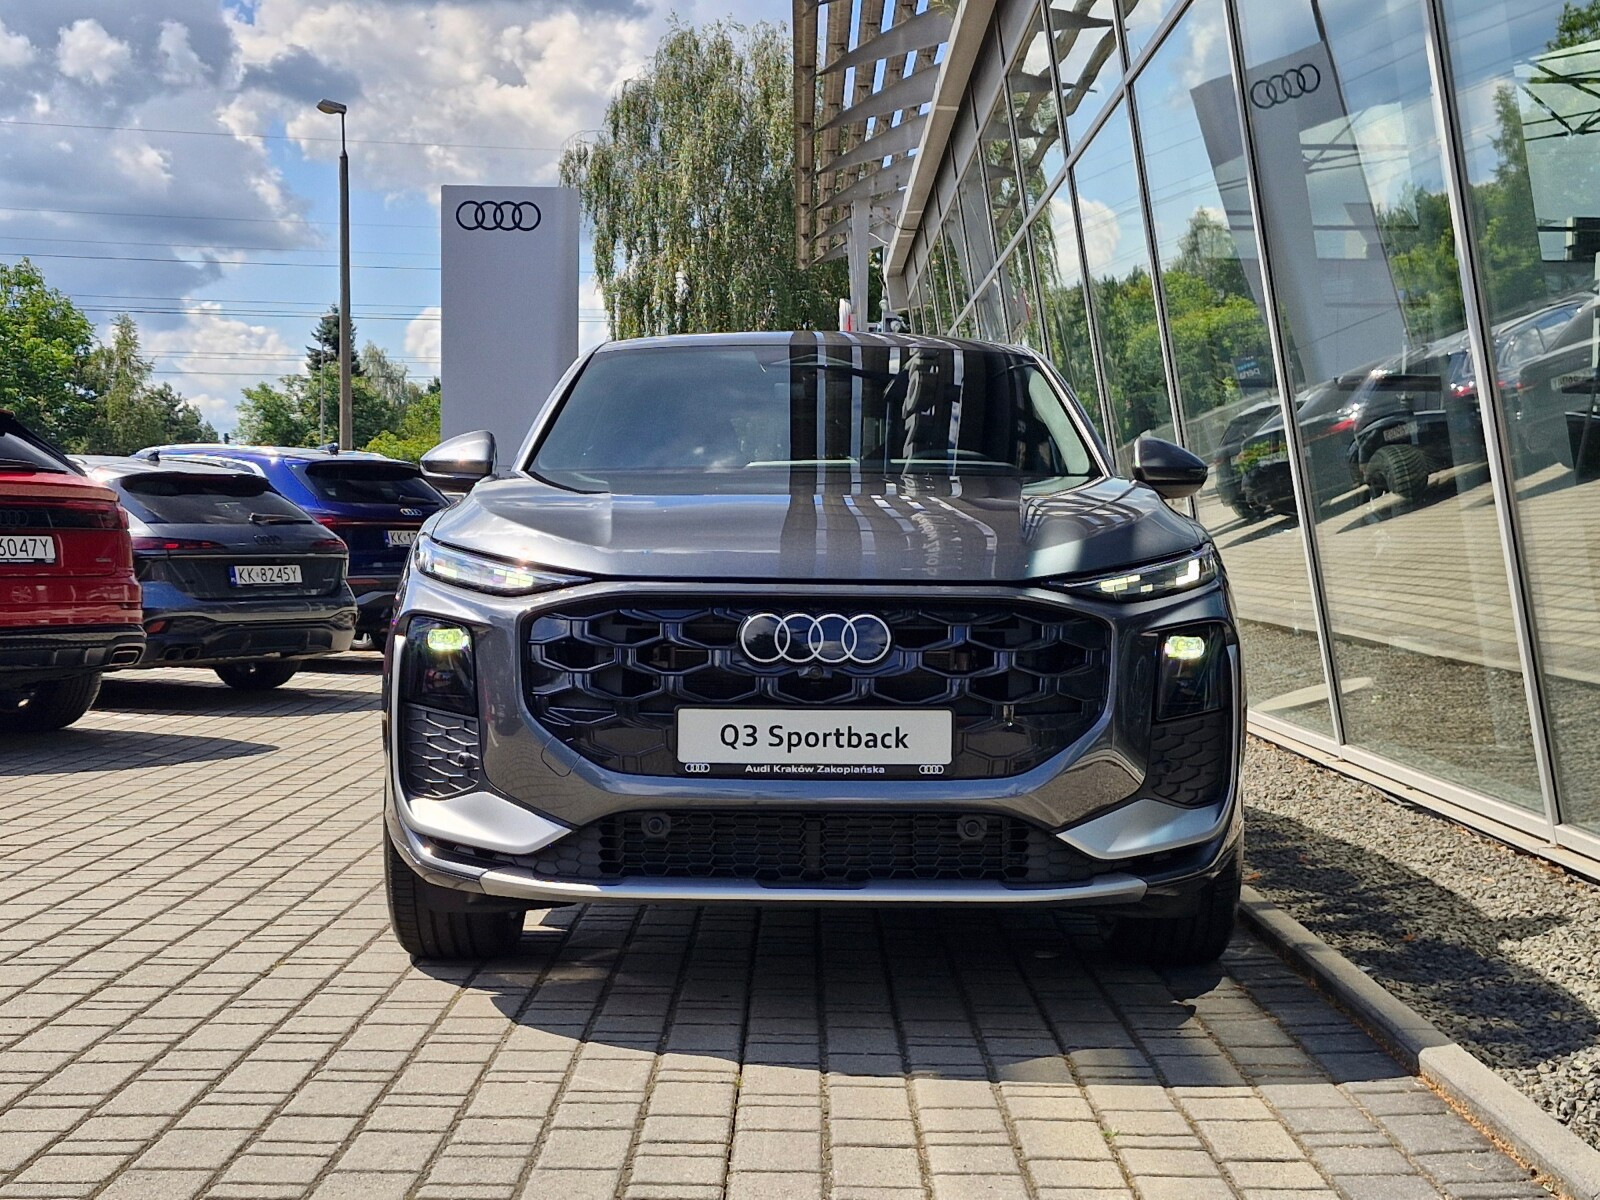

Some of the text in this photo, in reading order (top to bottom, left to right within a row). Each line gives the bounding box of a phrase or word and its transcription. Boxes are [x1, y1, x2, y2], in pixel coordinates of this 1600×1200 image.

[0, 538, 49, 557] 6047Y
[260, 566, 297, 583] 8245Y
[720, 723, 909, 754] Q3 Sportback
[744, 764, 885, 776] Audi Kraków Zakopiańska
